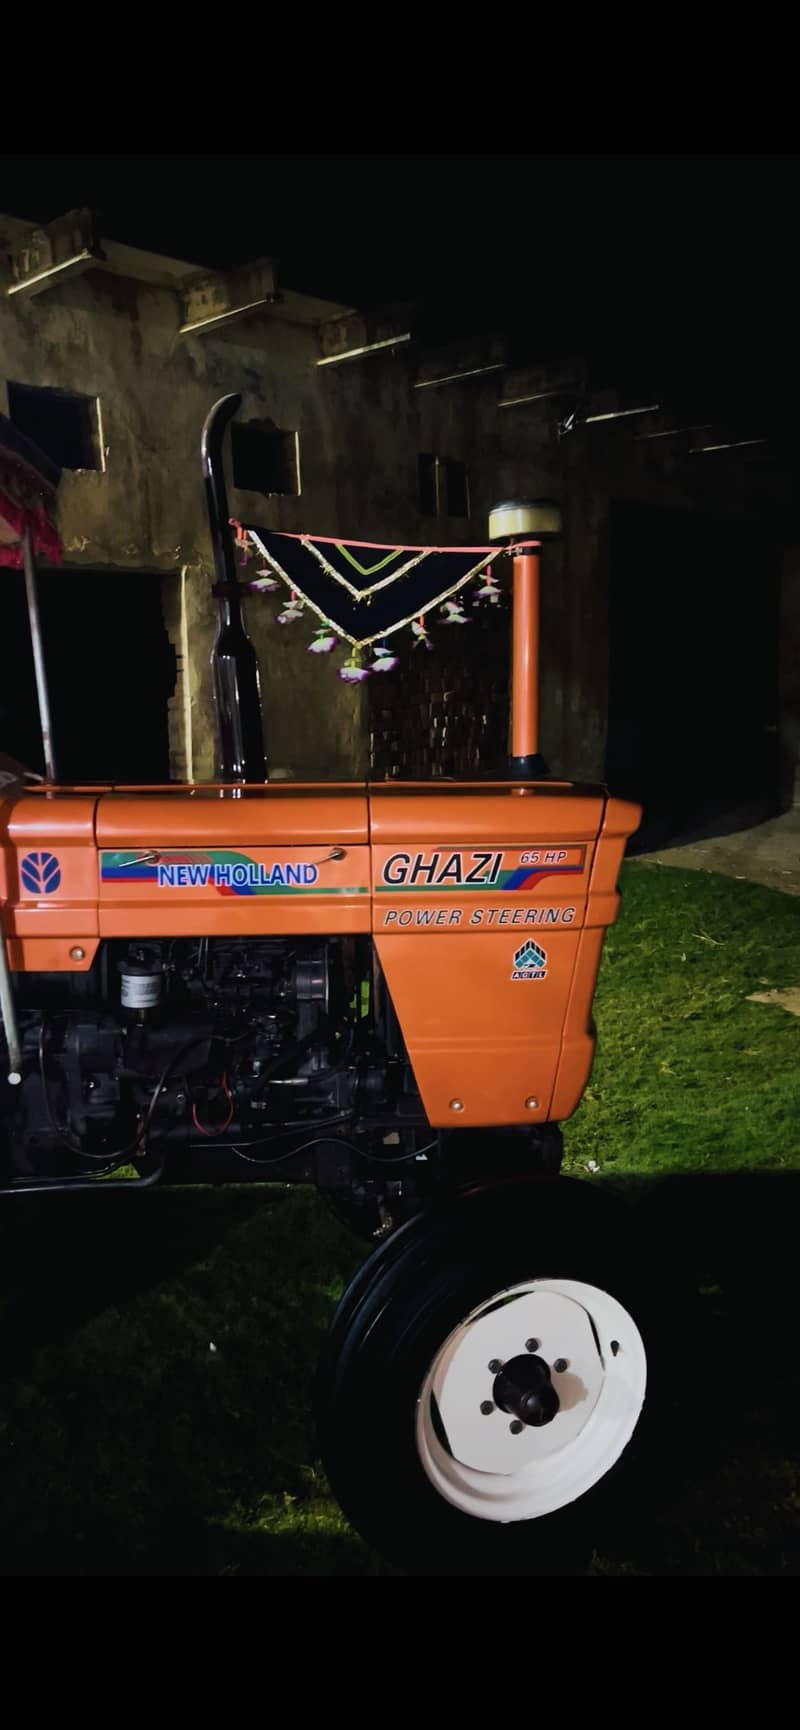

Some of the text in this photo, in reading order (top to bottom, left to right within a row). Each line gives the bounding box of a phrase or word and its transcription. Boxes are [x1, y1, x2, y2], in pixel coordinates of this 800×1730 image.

[521, 851, 567, 864] 65 HP
[158, 864, 318, 886] NEW HOLLAND
[384, 852, 503, 884] GHAZI
[384, 907, 575, 926] POWER STEERING
